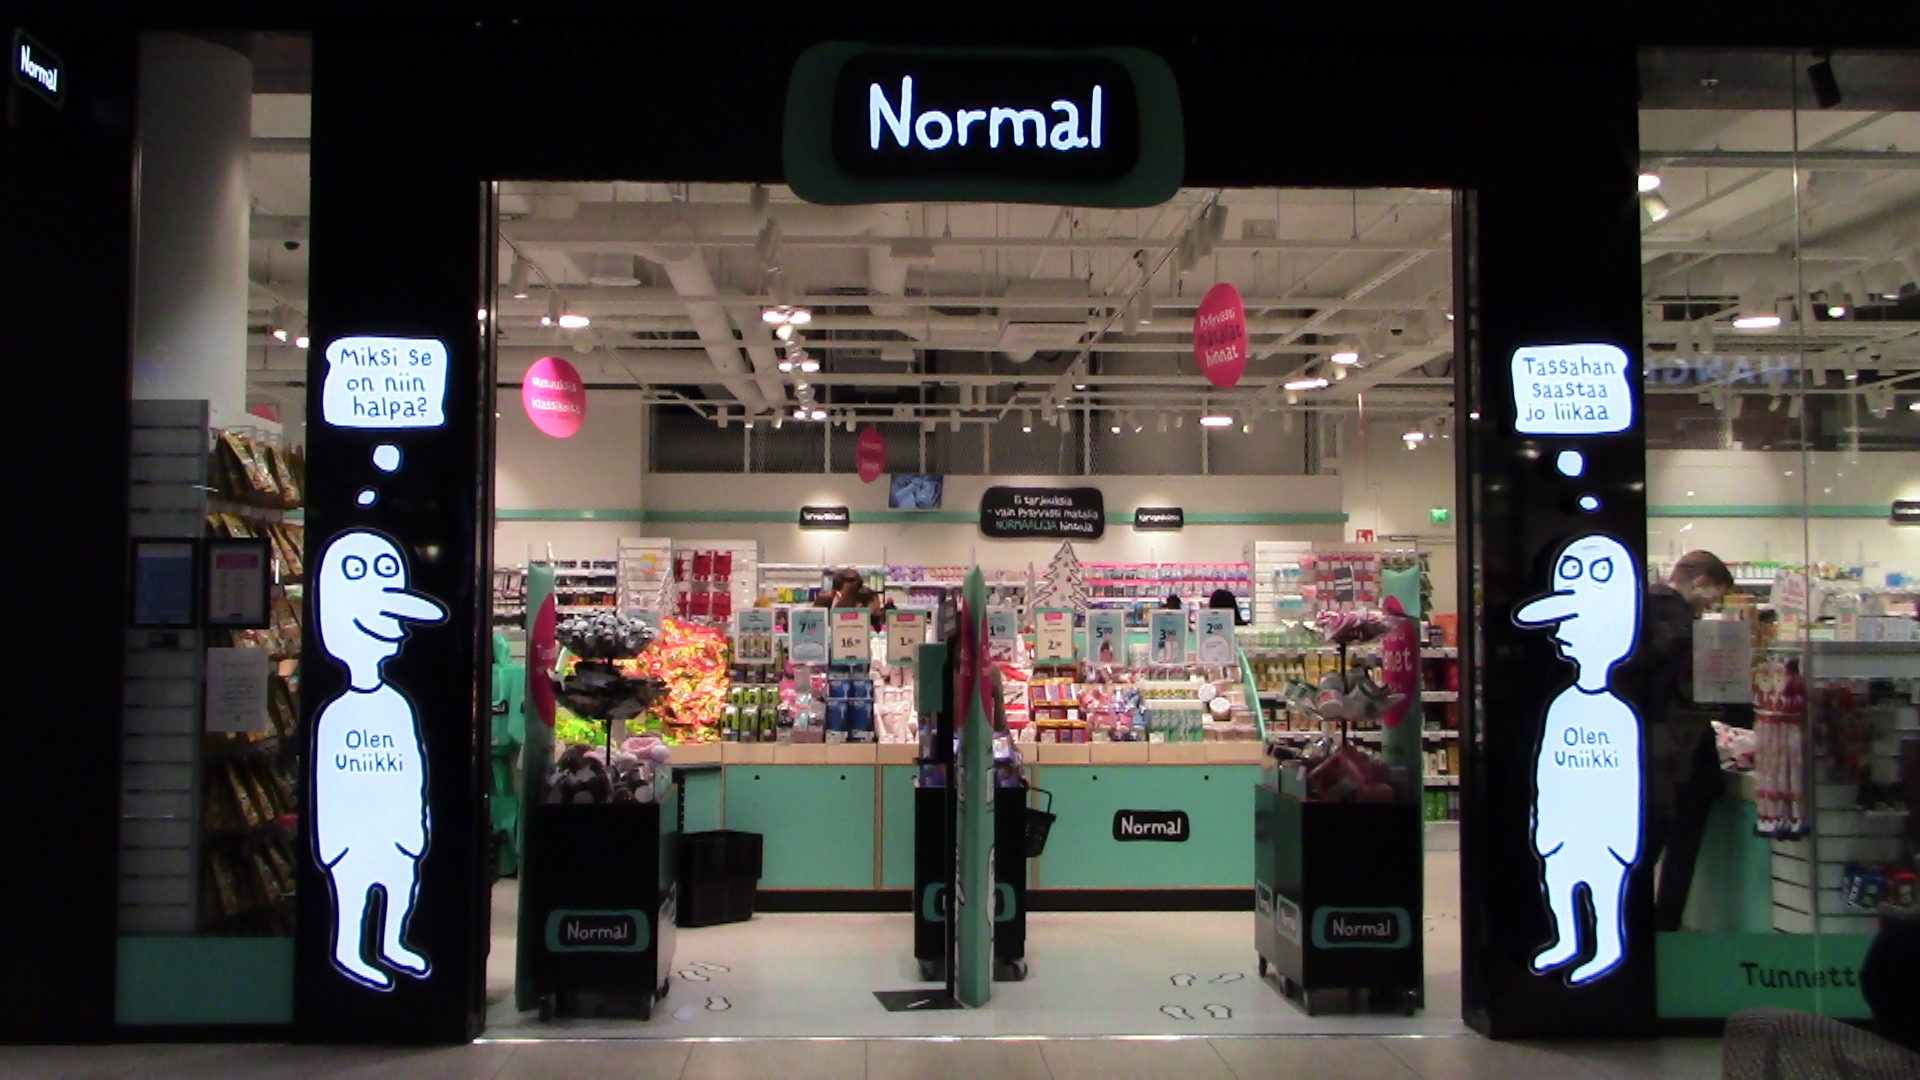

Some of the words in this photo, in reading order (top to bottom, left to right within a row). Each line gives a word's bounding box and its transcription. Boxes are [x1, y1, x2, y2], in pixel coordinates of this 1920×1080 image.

[20, 44, 58, 92] Normal
[869, 74, 1103, 151] Normal
[340, 346, 398, 367] Miksi
[408, 348, 432, 366] se
[1205, 344, 1239, 368] hinnat
[346, 376, 375, 393] on
[384, 372, 427, 393] niin
[352, 394, 428, 421] halpa?
[1524, 402, 1547, 423] jo
[1553, 400, 1611, 422] liikaa
[994, 508, 1016, 518] vain
[345, 728, 395, 749] Olen
[1563, 726, 1611, 747] Olen
[335, 752, 404, 773] Uniikki
[1554, 748, 1620, 769] Uniikki
[1121, 815, 1182, 836] Normal
[566, 920, 628, 940] Normal
[1332, 917, 1392, 937] Normal
[1739, 960, 1863, 989] Tunnett
